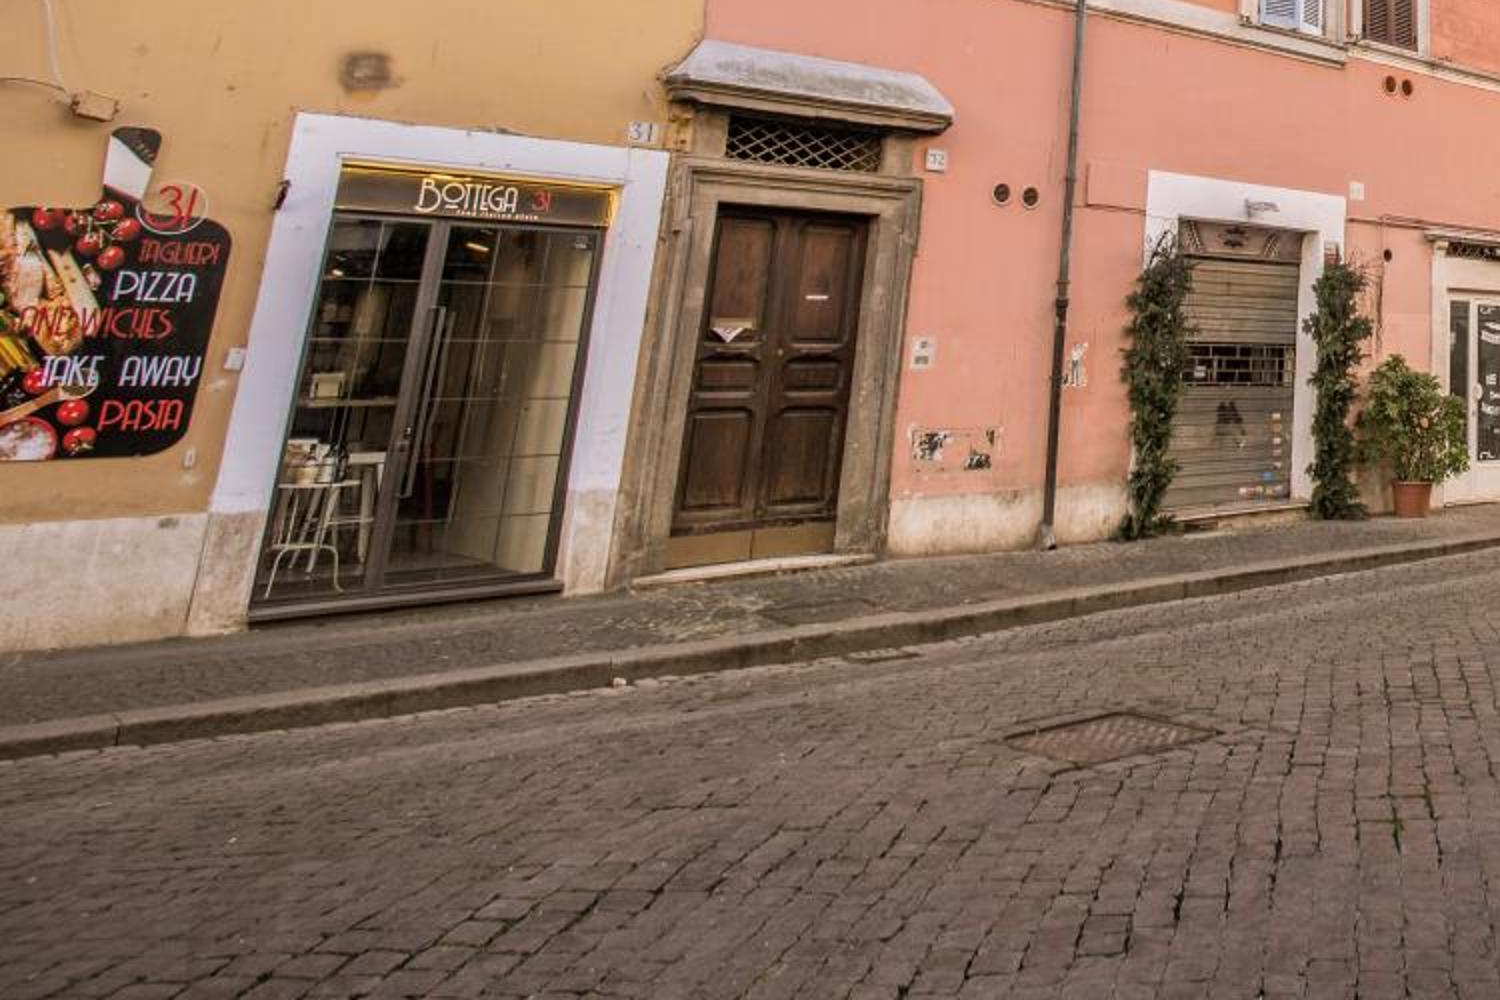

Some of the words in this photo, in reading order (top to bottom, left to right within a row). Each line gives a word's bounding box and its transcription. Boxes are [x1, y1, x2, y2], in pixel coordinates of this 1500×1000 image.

[629, 120, 653, 142] 31
[145, 184, 199, 230] 31
[414, 178, 519, 213] BOTTEGA
[531, 191, 551, 212] 31
[111, 270, 197, 303] PIZZA
[9, 305, 174, 339] ANDWICHES
[39, 354, 105, 387] TAKE
[117, 354, 202, 388] AWAY
[97, 399, 184, 432] PASTA
